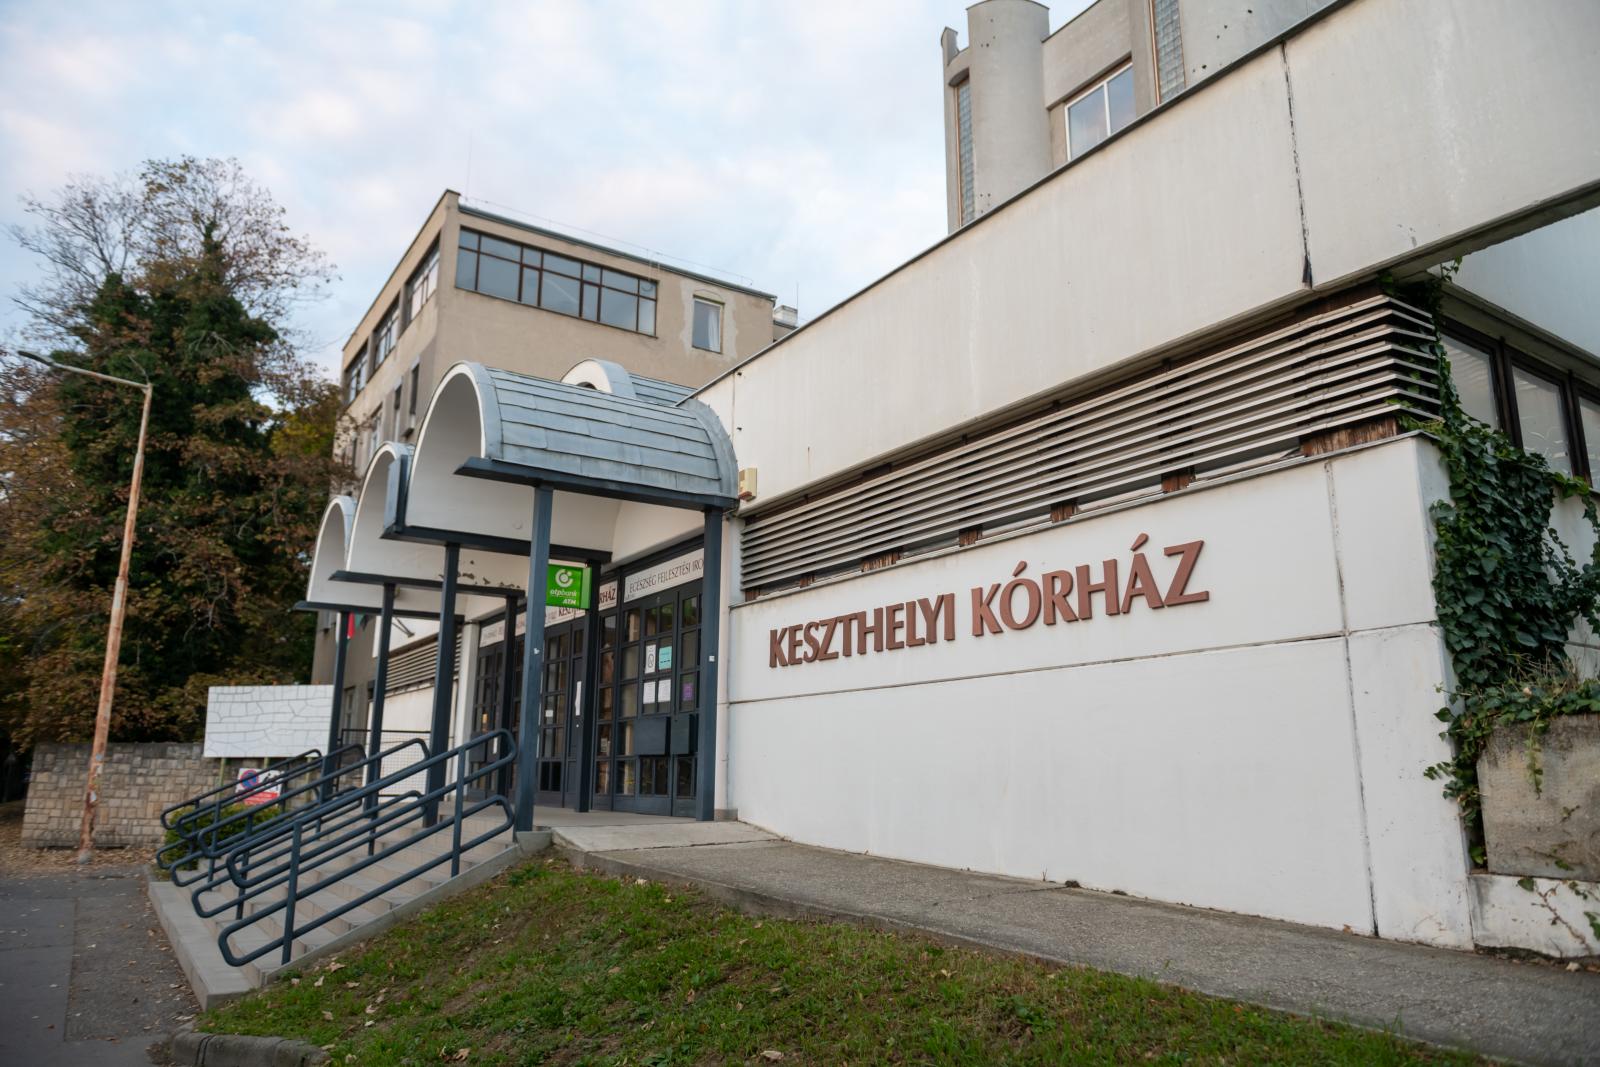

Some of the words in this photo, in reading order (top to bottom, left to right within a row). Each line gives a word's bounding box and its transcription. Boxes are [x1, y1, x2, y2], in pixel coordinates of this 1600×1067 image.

[629, 573, 657, 593] EGÉSZSÉG
[657, 561, 691, 584] FEJLESZTÉSI
[692, 558, 704, 573] IRO
[549, 588, 577, 599] otpbank
[562, 598, 577, 606] ATM
[769, 592, 956, 668] KESZTHELYI
[970, 533, 1210, 637] KÓRHÁZ
